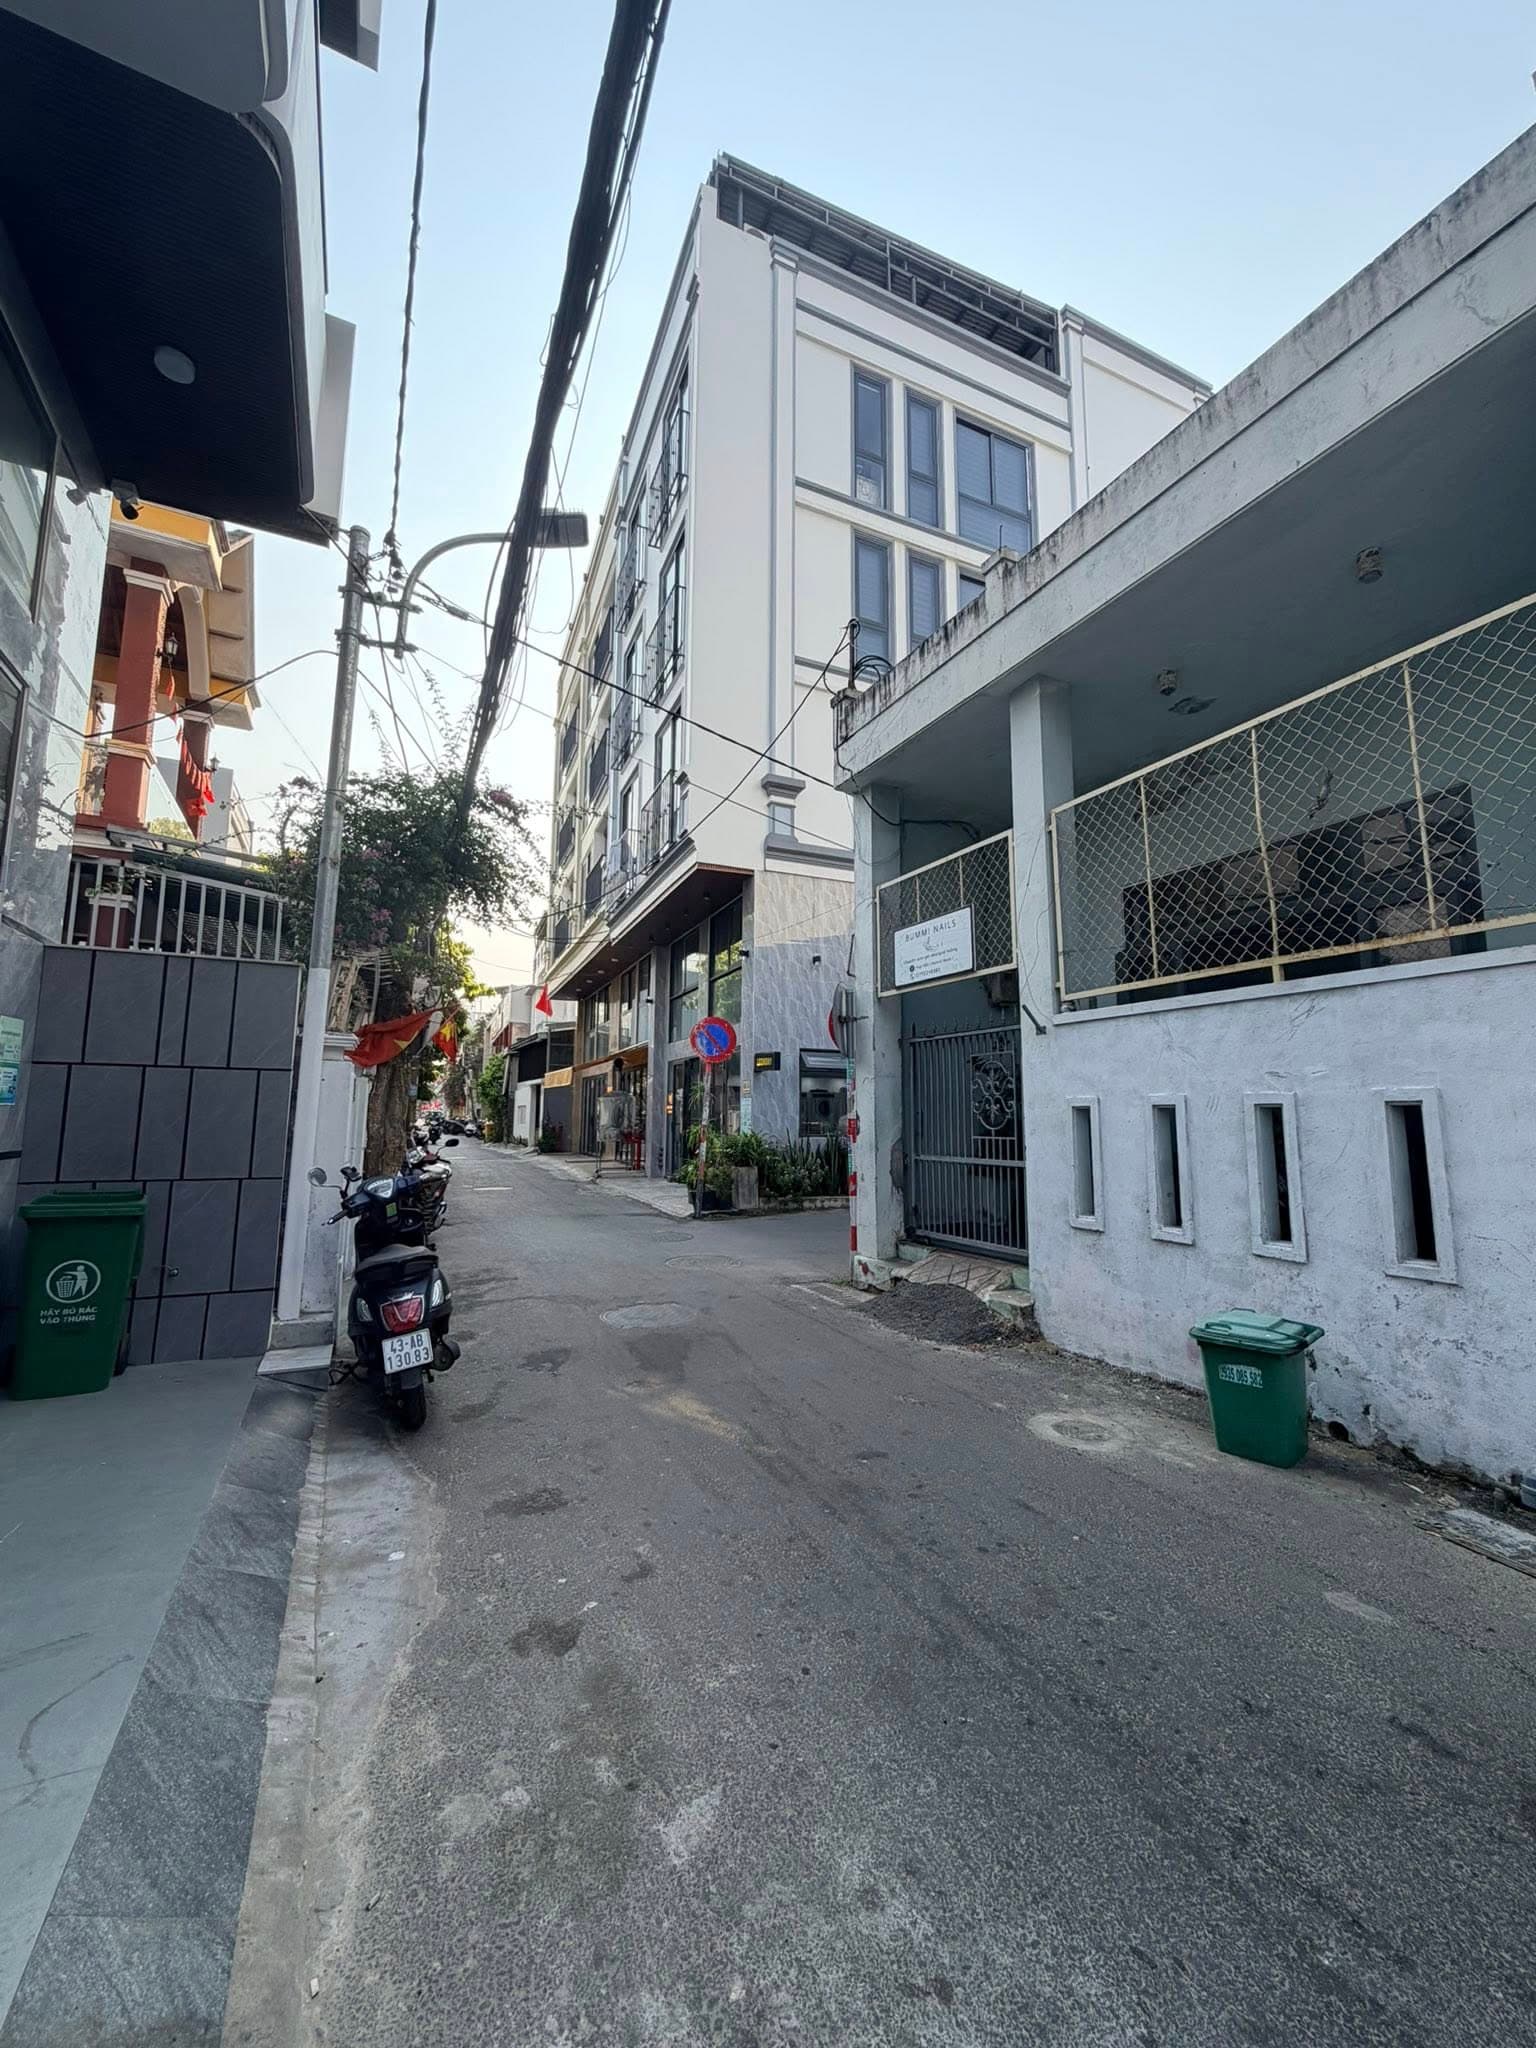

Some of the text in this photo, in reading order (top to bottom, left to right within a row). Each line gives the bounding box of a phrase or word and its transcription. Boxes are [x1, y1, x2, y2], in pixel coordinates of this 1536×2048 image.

[933, 919, 957, 934] NAILS
[78, 1304, 98, 1315] RÁC
[390, 1333, 424, 1354] 43-AB
[387, 1347, 430, 1370] 130.83
